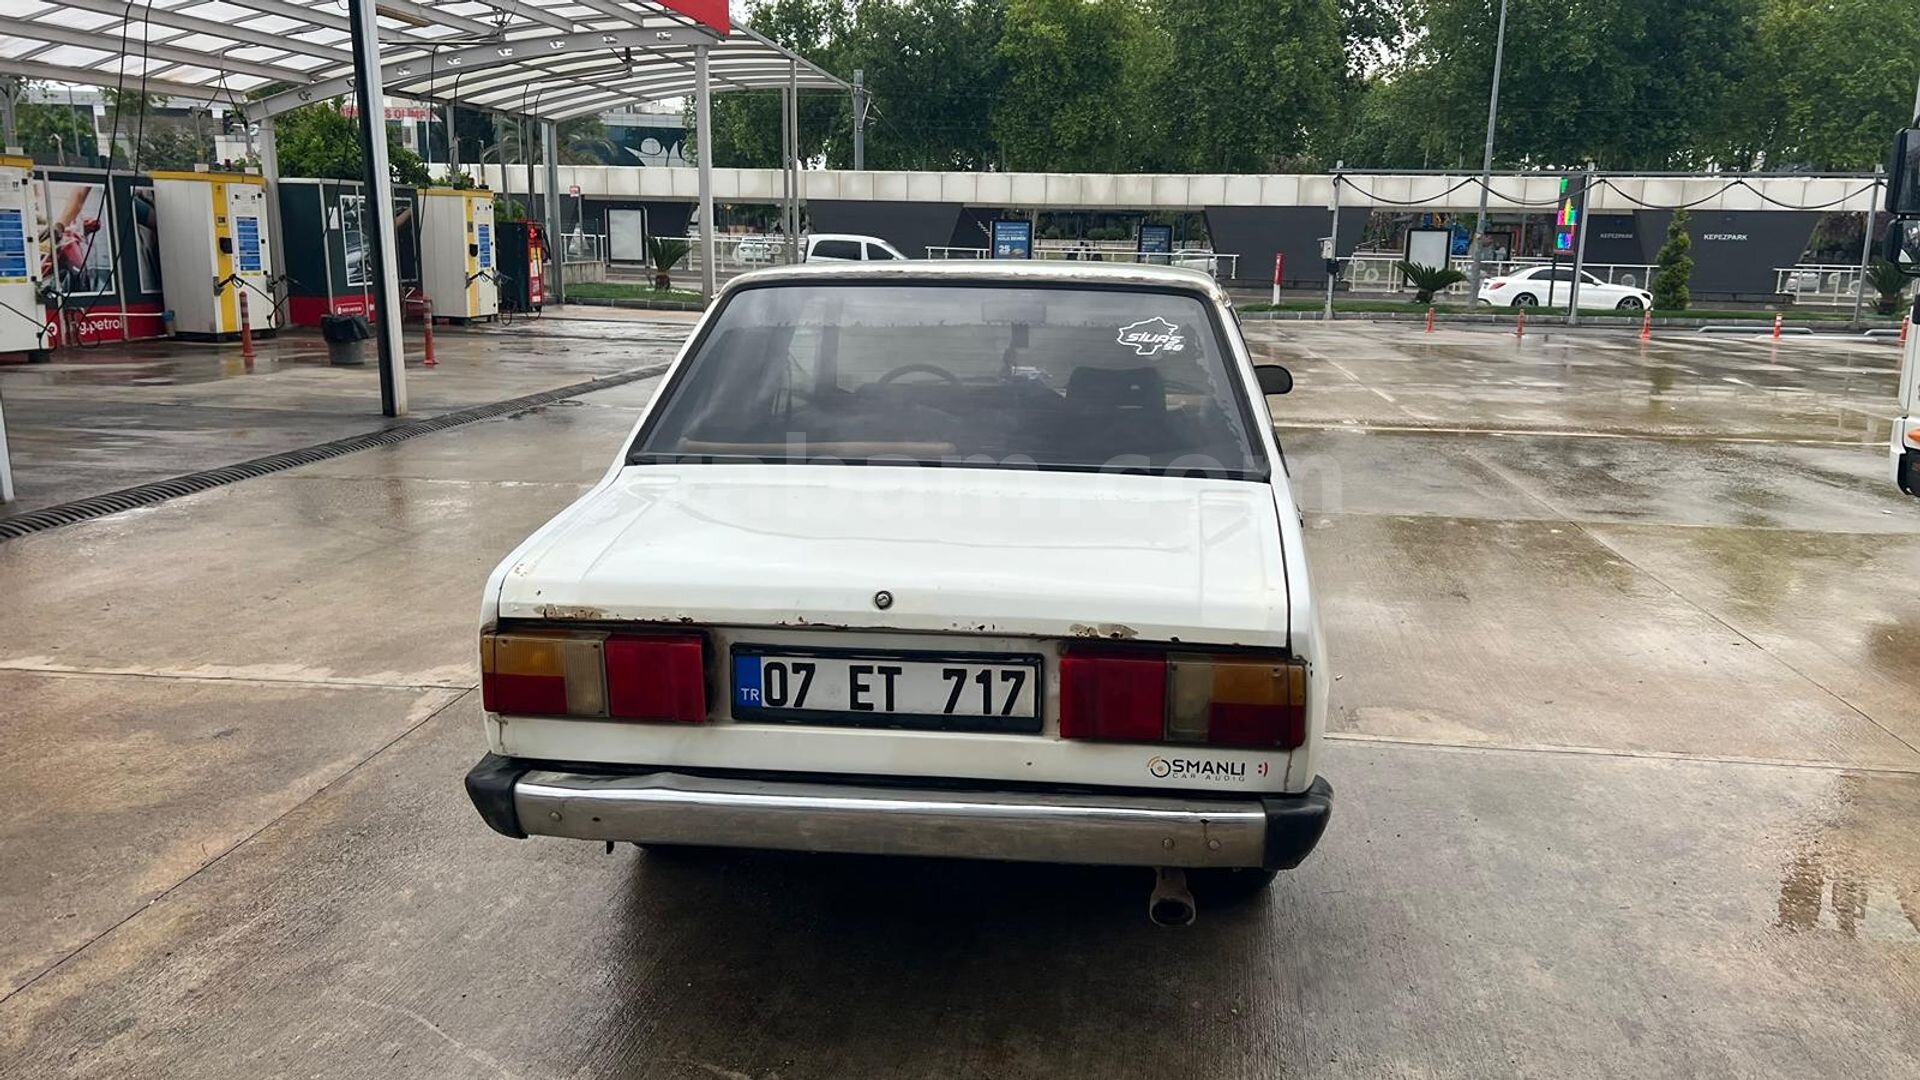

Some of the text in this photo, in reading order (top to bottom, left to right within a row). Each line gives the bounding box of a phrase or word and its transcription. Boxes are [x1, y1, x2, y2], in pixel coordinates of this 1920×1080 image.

[741, 661, 1026, 716] TR 07 ET 717
[1205, 774, 1246, 782] AUDIO
